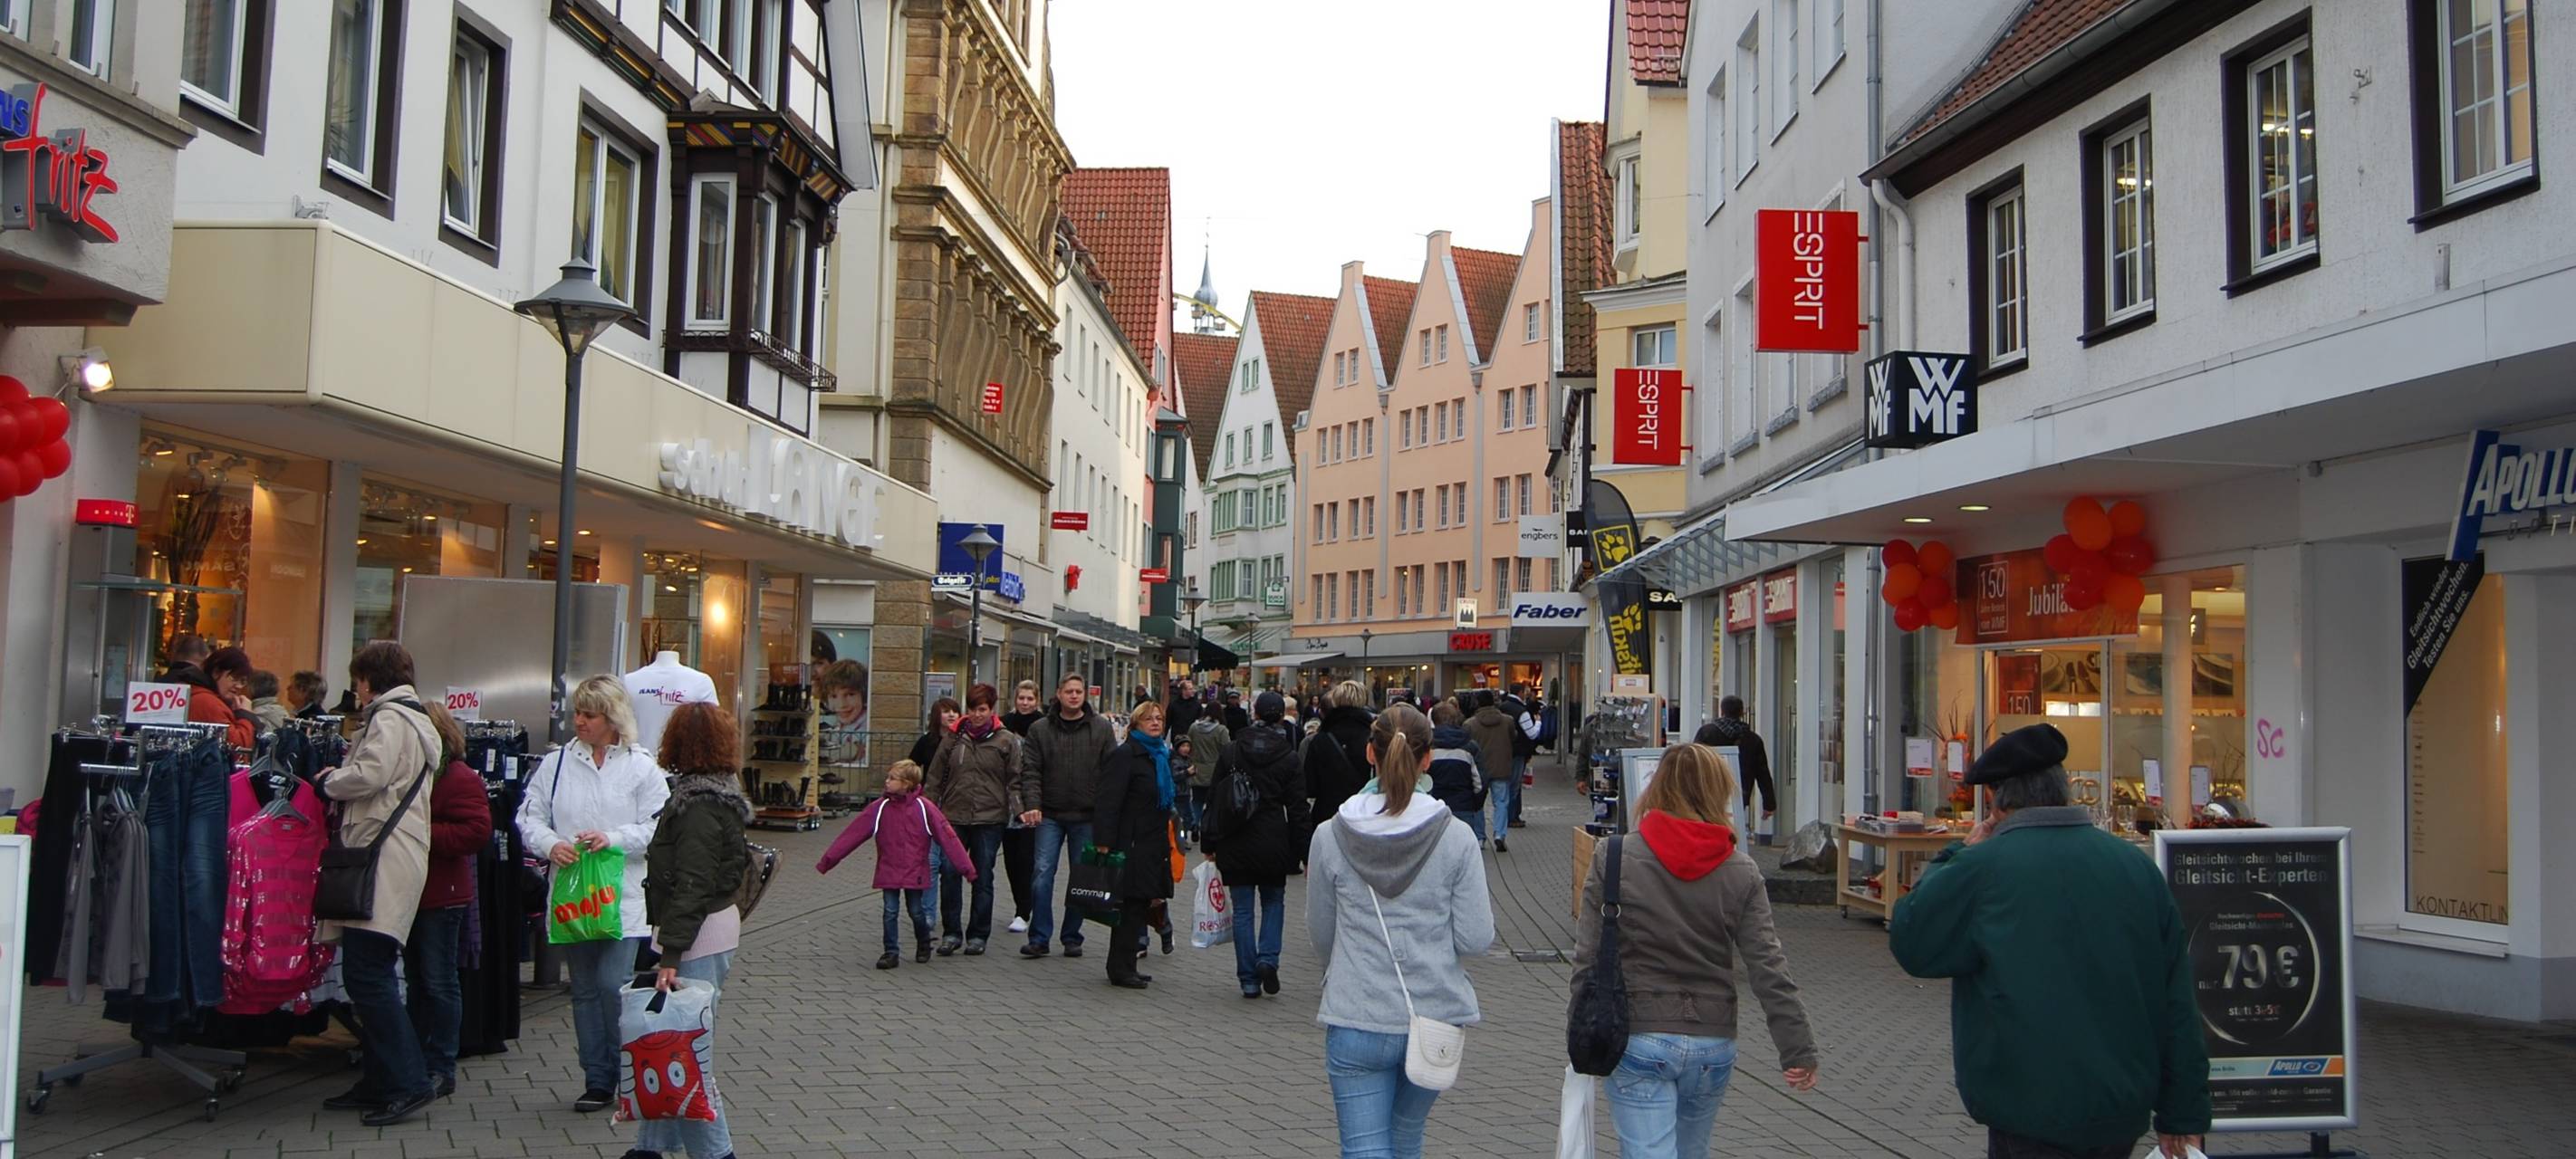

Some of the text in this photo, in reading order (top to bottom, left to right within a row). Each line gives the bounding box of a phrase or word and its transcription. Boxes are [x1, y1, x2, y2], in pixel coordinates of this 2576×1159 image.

[1793, 212, 1824, 330] ESPRIT
[1638, 370, 1659, 450] ESPRIT
[1521, 532, 1559, 541] engbers
[1980, 567, 2005, 599] 150
[1649, 591, 1684, 603] SA
[2025, 583, 2075, 618] Jubilä
[2409, 566, 2450, 637] Endlich wieder
[1513, 604, 1588, 618] Faber
[1450, 632, 1492, 651] CRUSE
[2422, 633, 2446, 669] Testen
[2442, 612, 2456, 633] Sie
[132, 686, 187, 713] 20%
[447, 690, 479, 710] 20%
[2275, 851, 2292, 864] bei
[2218, 943, 2299, 989] 79 €
[2274, 1060, 2302, 1071] APOLLO
